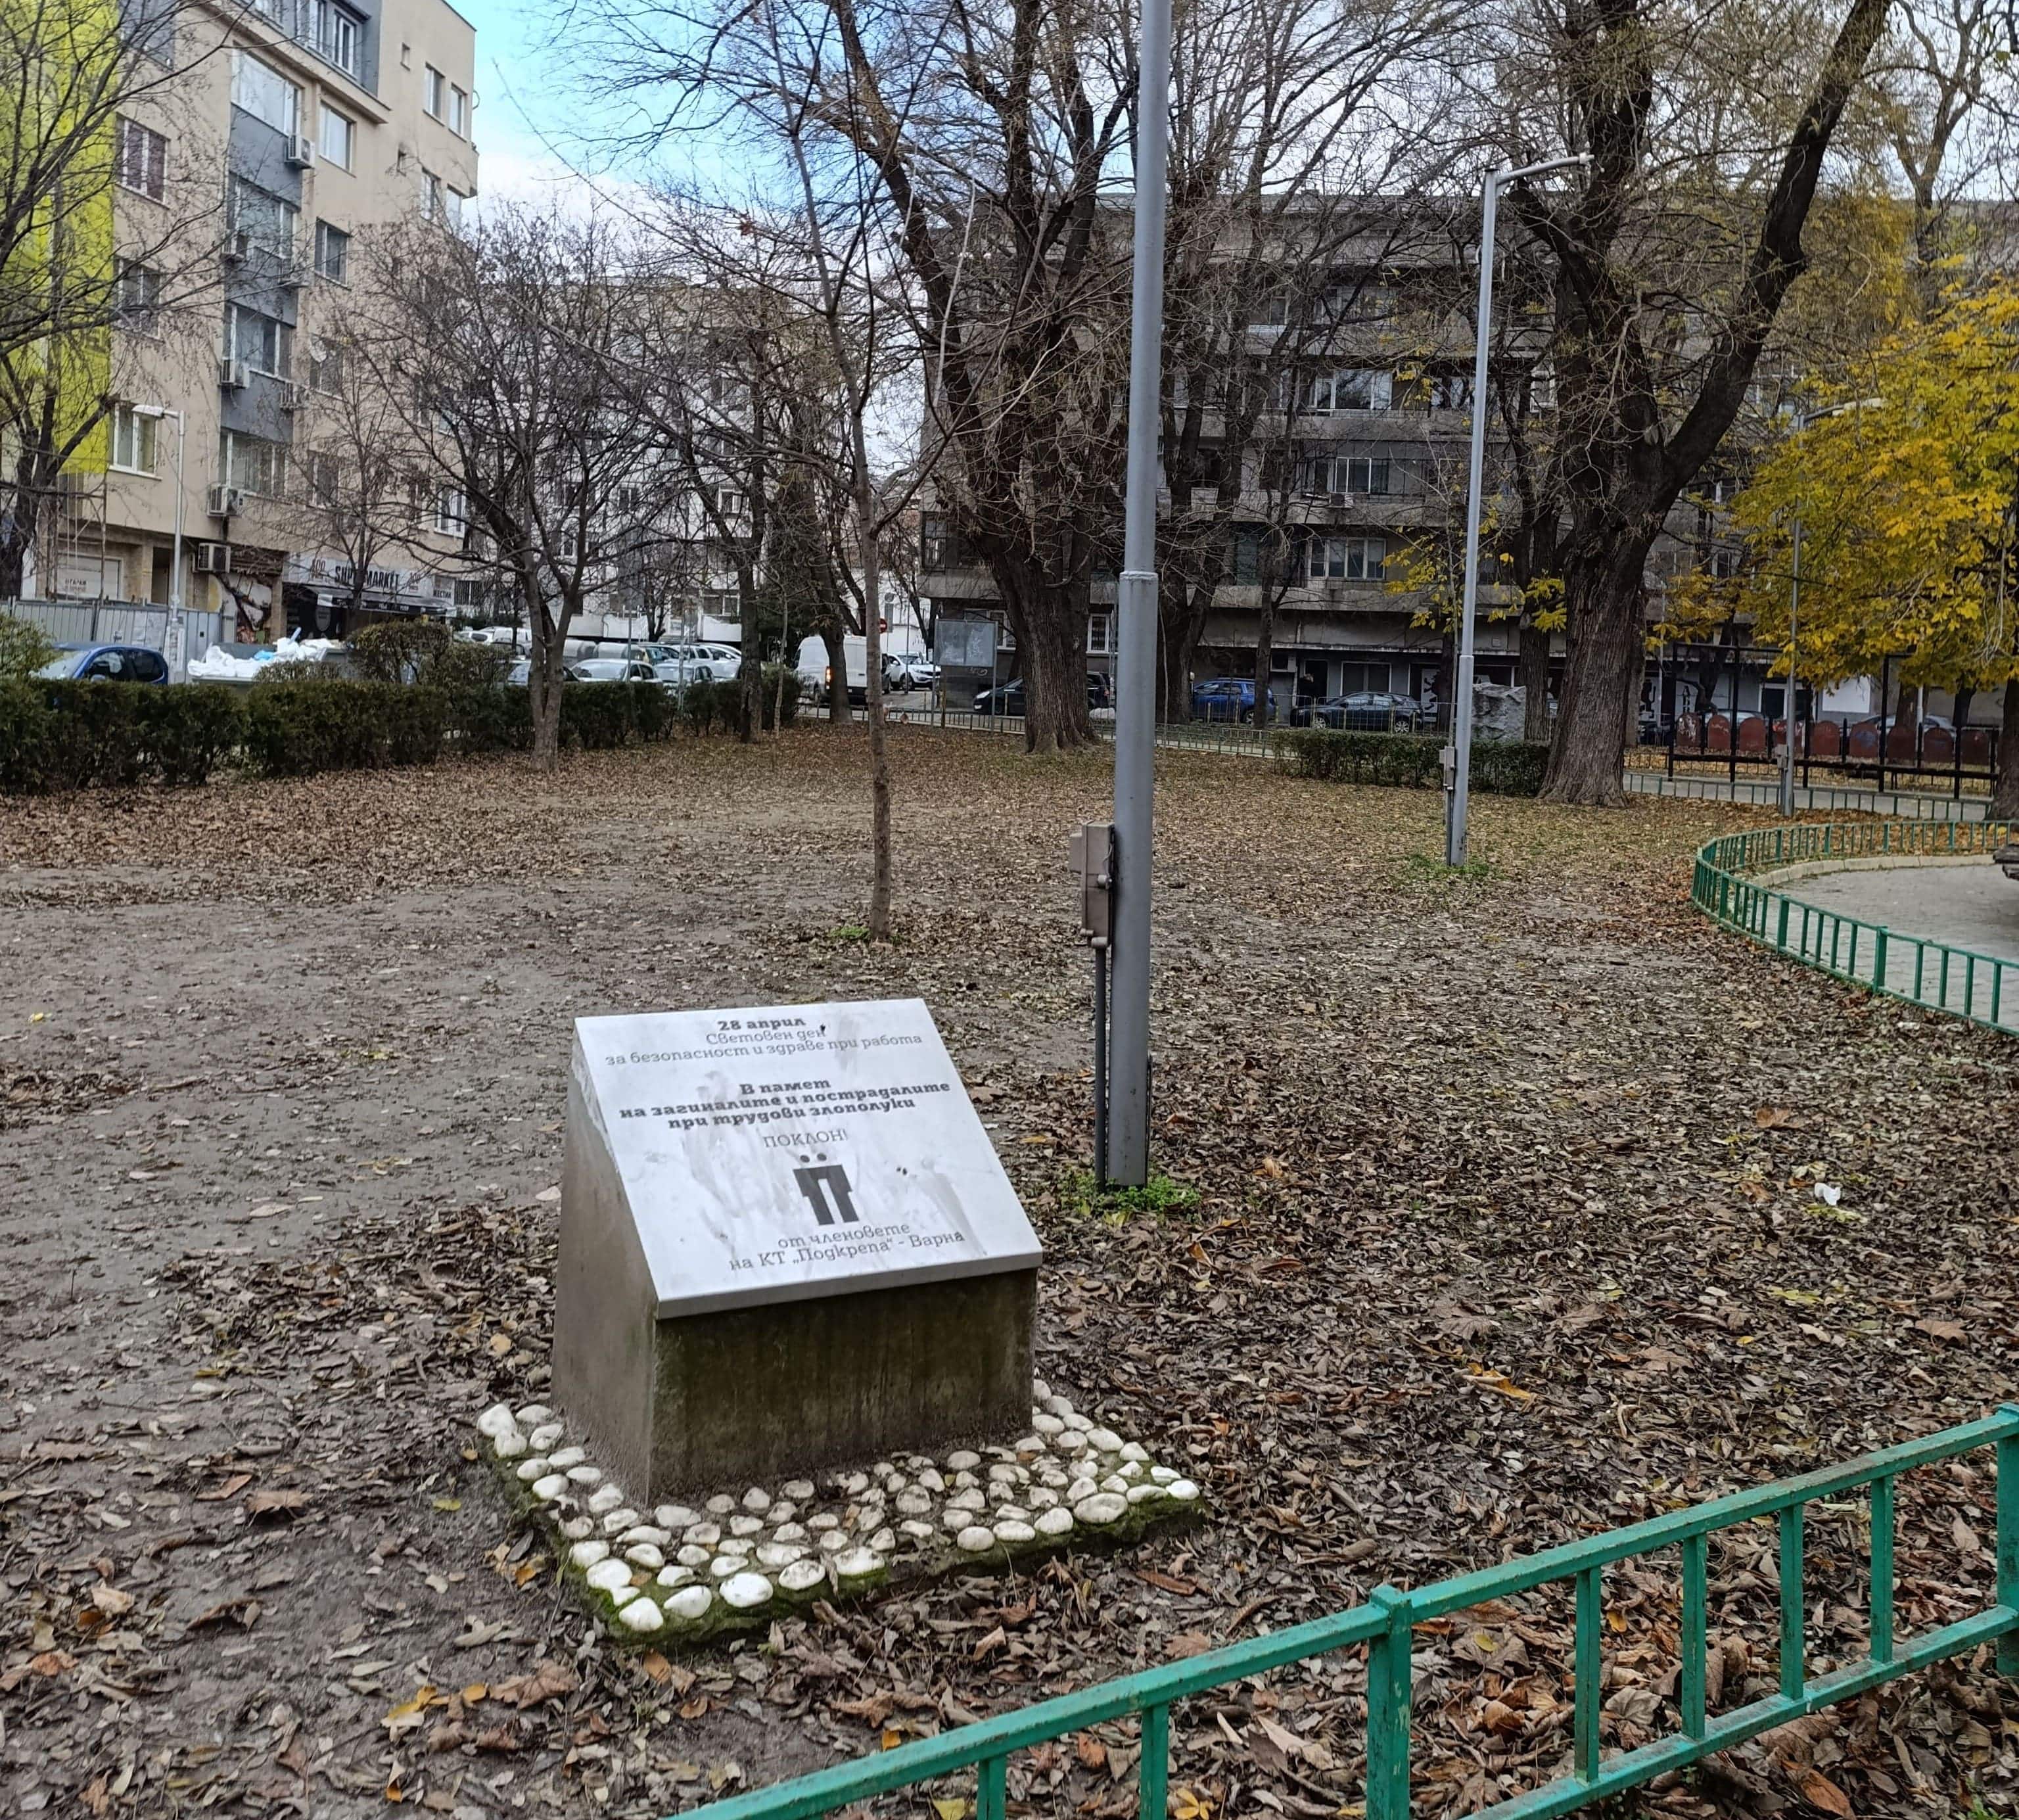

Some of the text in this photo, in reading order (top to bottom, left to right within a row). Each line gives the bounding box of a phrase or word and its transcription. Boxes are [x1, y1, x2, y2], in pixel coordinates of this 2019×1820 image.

[335, 565, 400, 590] SUPMARKET
[718, 1017, 806, 1031] 28 април
[605, 1033, 923, 1065] за безопасност и здраве при работа
[706, 1029, 826, 1045] Световен ден
[739, 1079, 831, 1096] В памет
[619, 1083, 951, 1119] на загиналите и пострадалите
[668, 1098, 916, 1131] при трудови злополуки
[762, 1129, 848, 1148] ПОКЛОН!
[777, 1223, 911, 1249] от членовете
[728, 1259, 754, 1271] на
[757, 1251, 786, 1267] КТ
[908, 1230, 966, 1248] Варна
